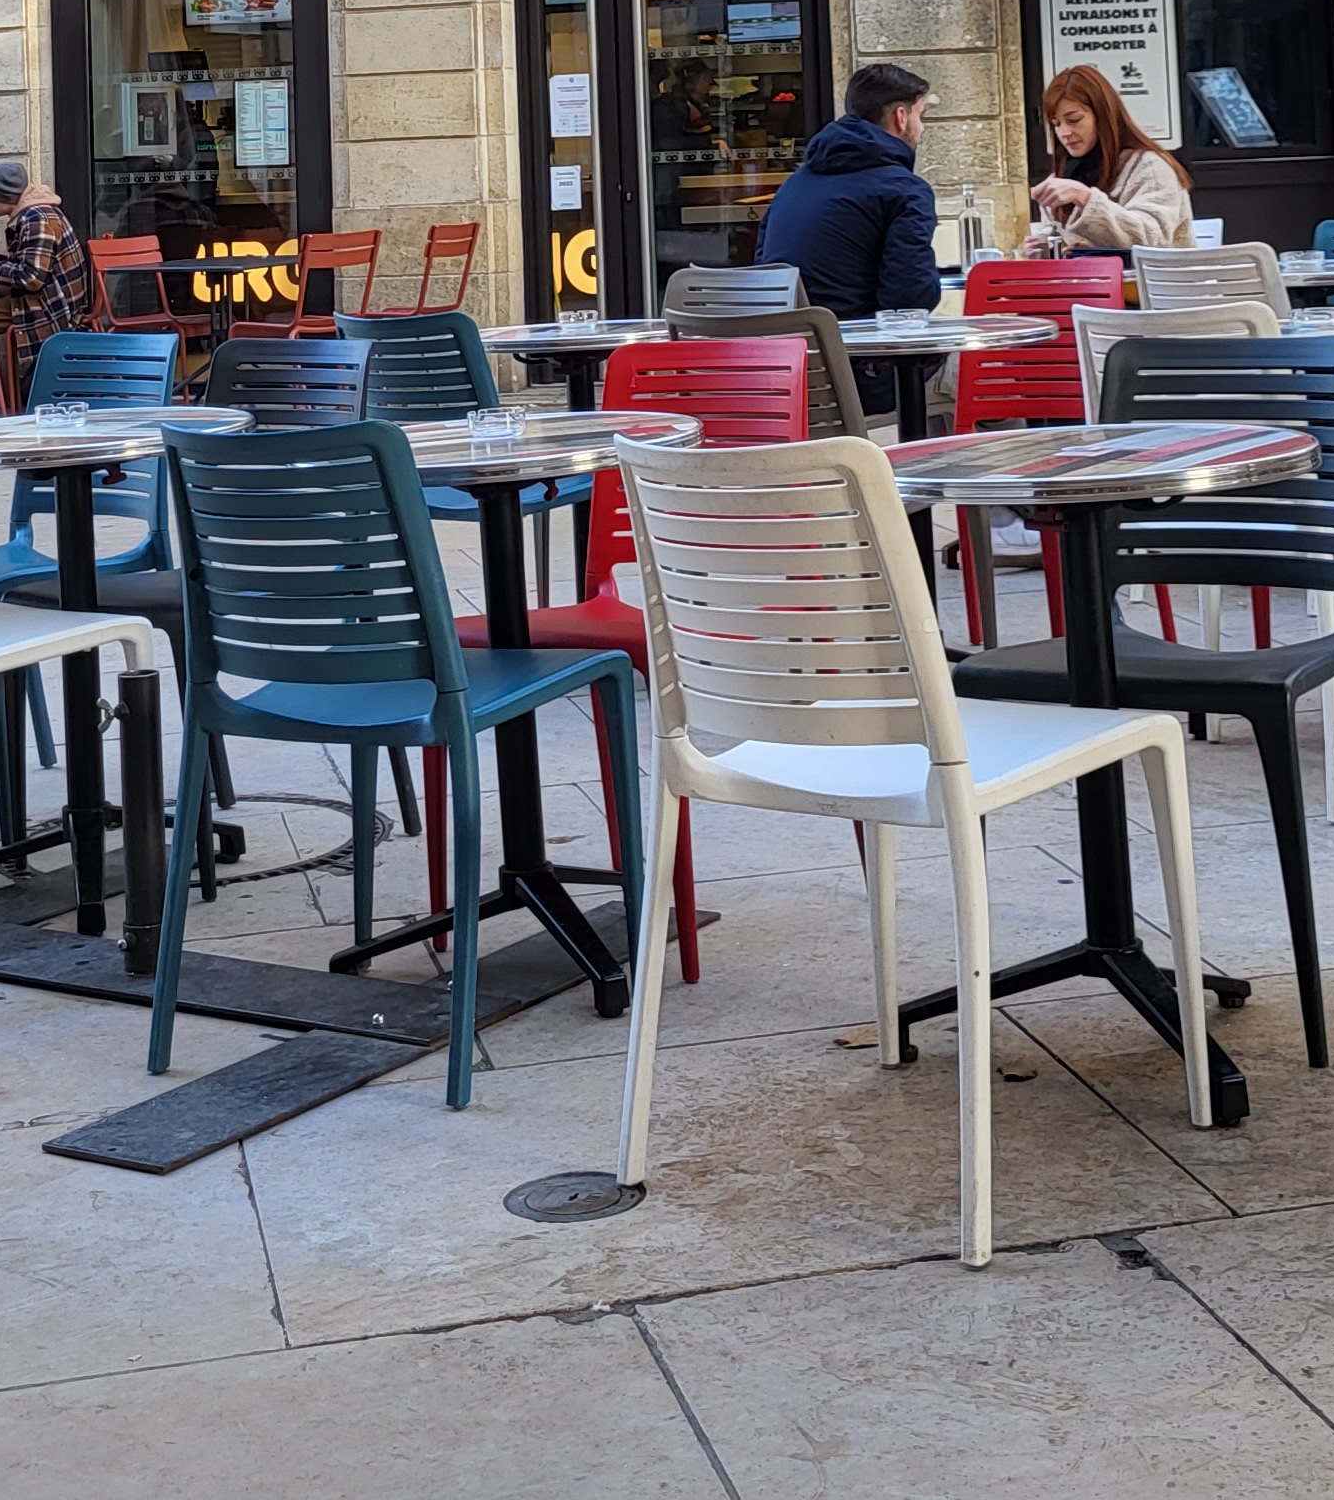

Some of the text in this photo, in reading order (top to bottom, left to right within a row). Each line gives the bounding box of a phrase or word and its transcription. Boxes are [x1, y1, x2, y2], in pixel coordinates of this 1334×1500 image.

[1058, 8, 1158, 21] LIVRAISONS ET
[1060, 21, 1158, 37] COMMANDES À
[1073, 40, 1146, 52] EMPORTER
